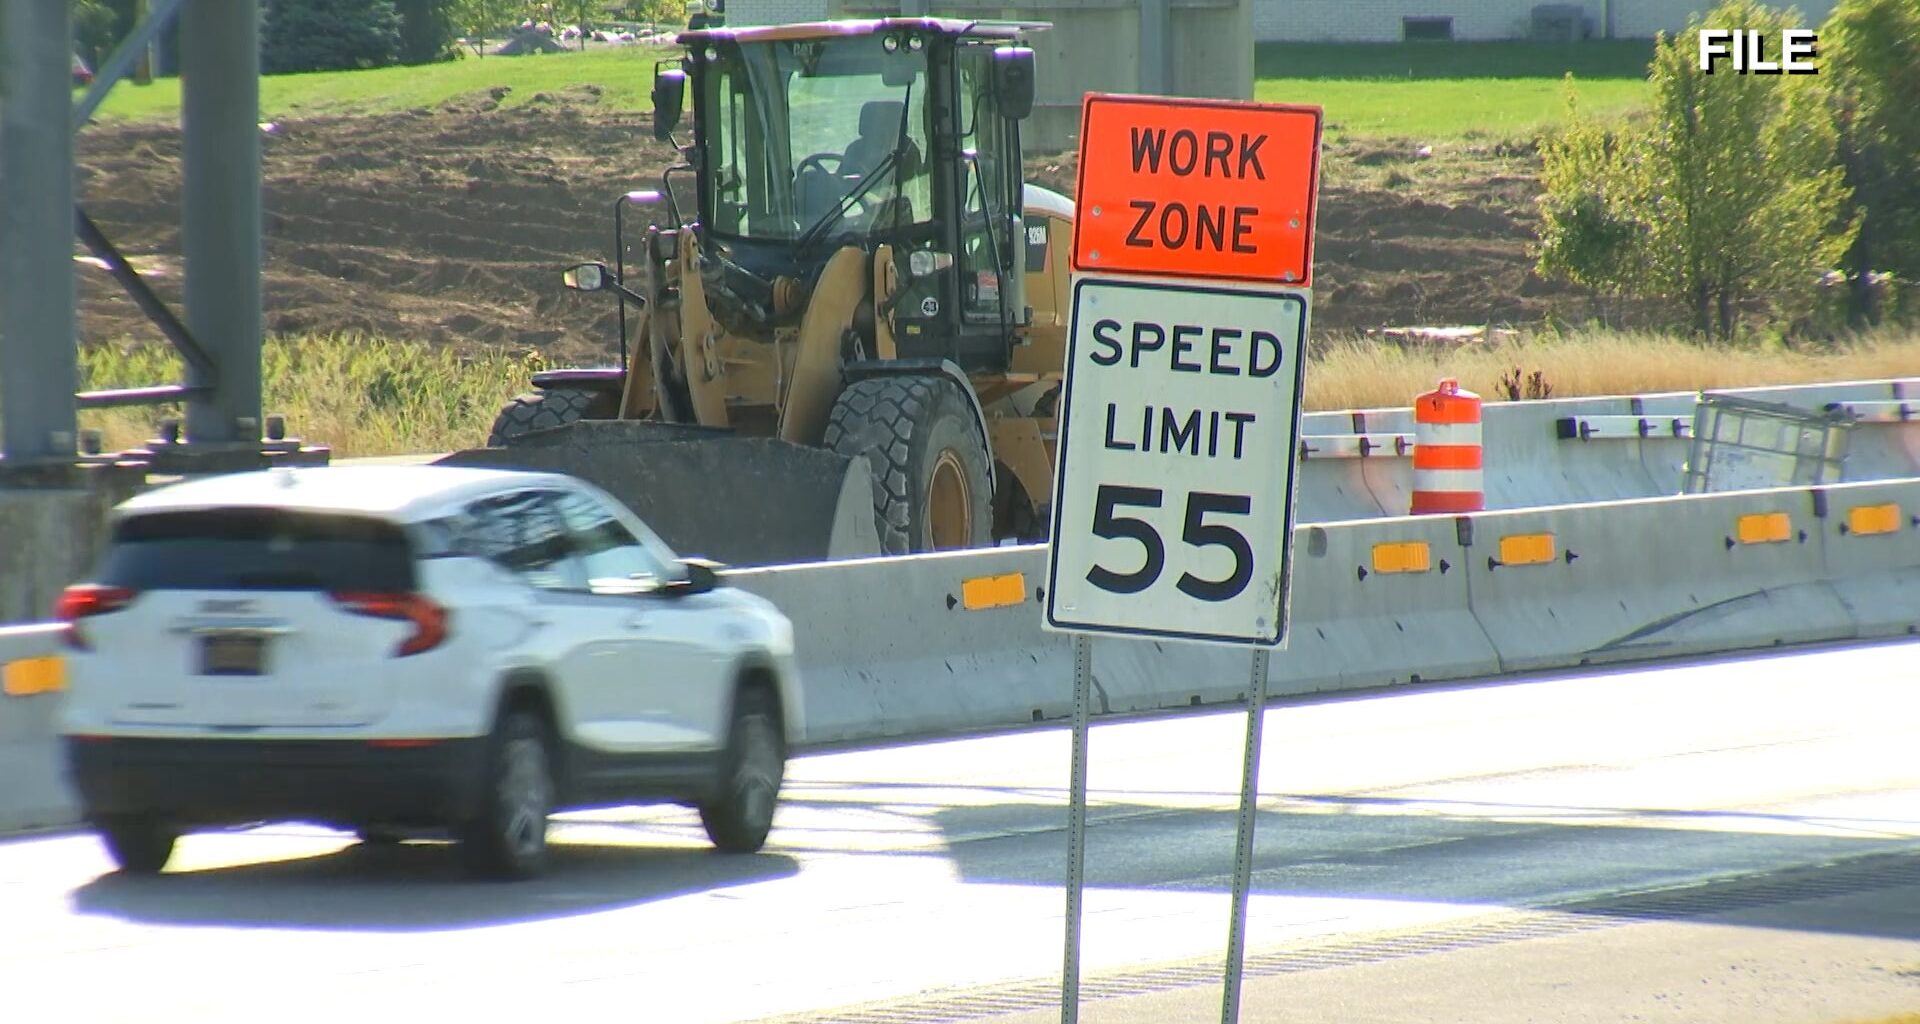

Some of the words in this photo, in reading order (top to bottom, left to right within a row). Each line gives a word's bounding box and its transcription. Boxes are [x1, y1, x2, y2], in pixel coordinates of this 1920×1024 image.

[1131, 127, 1268, 180] WORK
[1126, 200, 1258, 254] ZONE
[1090, 319, 1283, 378] SPEED
[1105, 403, 1256, 459] LIMIT
[1085, 485, 1254, 602] 55
